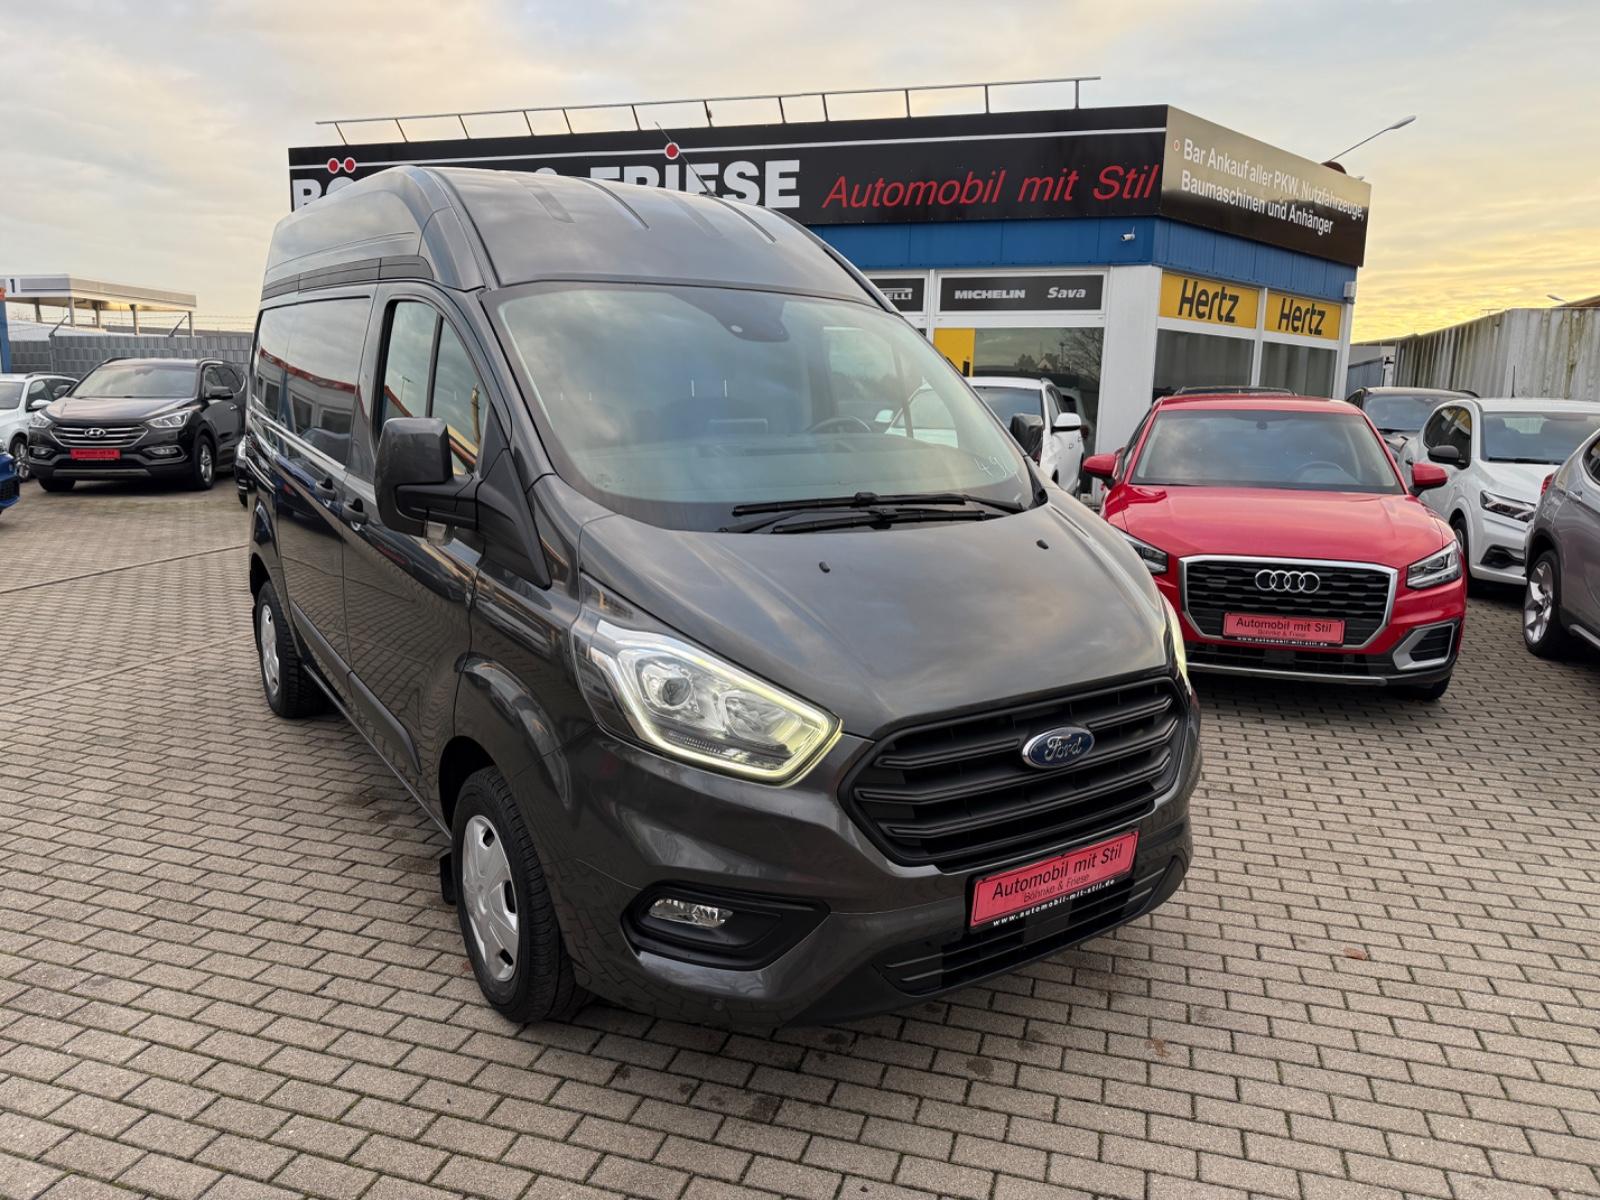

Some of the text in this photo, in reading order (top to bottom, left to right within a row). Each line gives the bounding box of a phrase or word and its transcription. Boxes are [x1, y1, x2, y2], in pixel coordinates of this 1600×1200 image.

[822, 164, 1159, 208] Automobil mit Stil
[1183, 138, 1206, 164] Bar
[1207, 148, 1249, 180] Ankauf
[1249, 163, 1273, 187] aller
[1300, 182, 1364, 221] Nutzfahrzeuge,
[1181, 170, 1333, 235] Baumaschinen und Anhänger
[954, 289, 1026, 299] MICHELIN
[1047, 287, 1087, 299] Sava
[1178, 279, 1239, 323] Hertz
[1277, 298, 1326, 336] Hertz
[1236, 617, 1290, 630] Automobil
[1293, 622, 1311, 631] mit
[1314, 622, 1332, 633] Stil
[1044, 734, 1082, 761] Ford
[992, 843, 1122, 900] Automobil mit Stil
